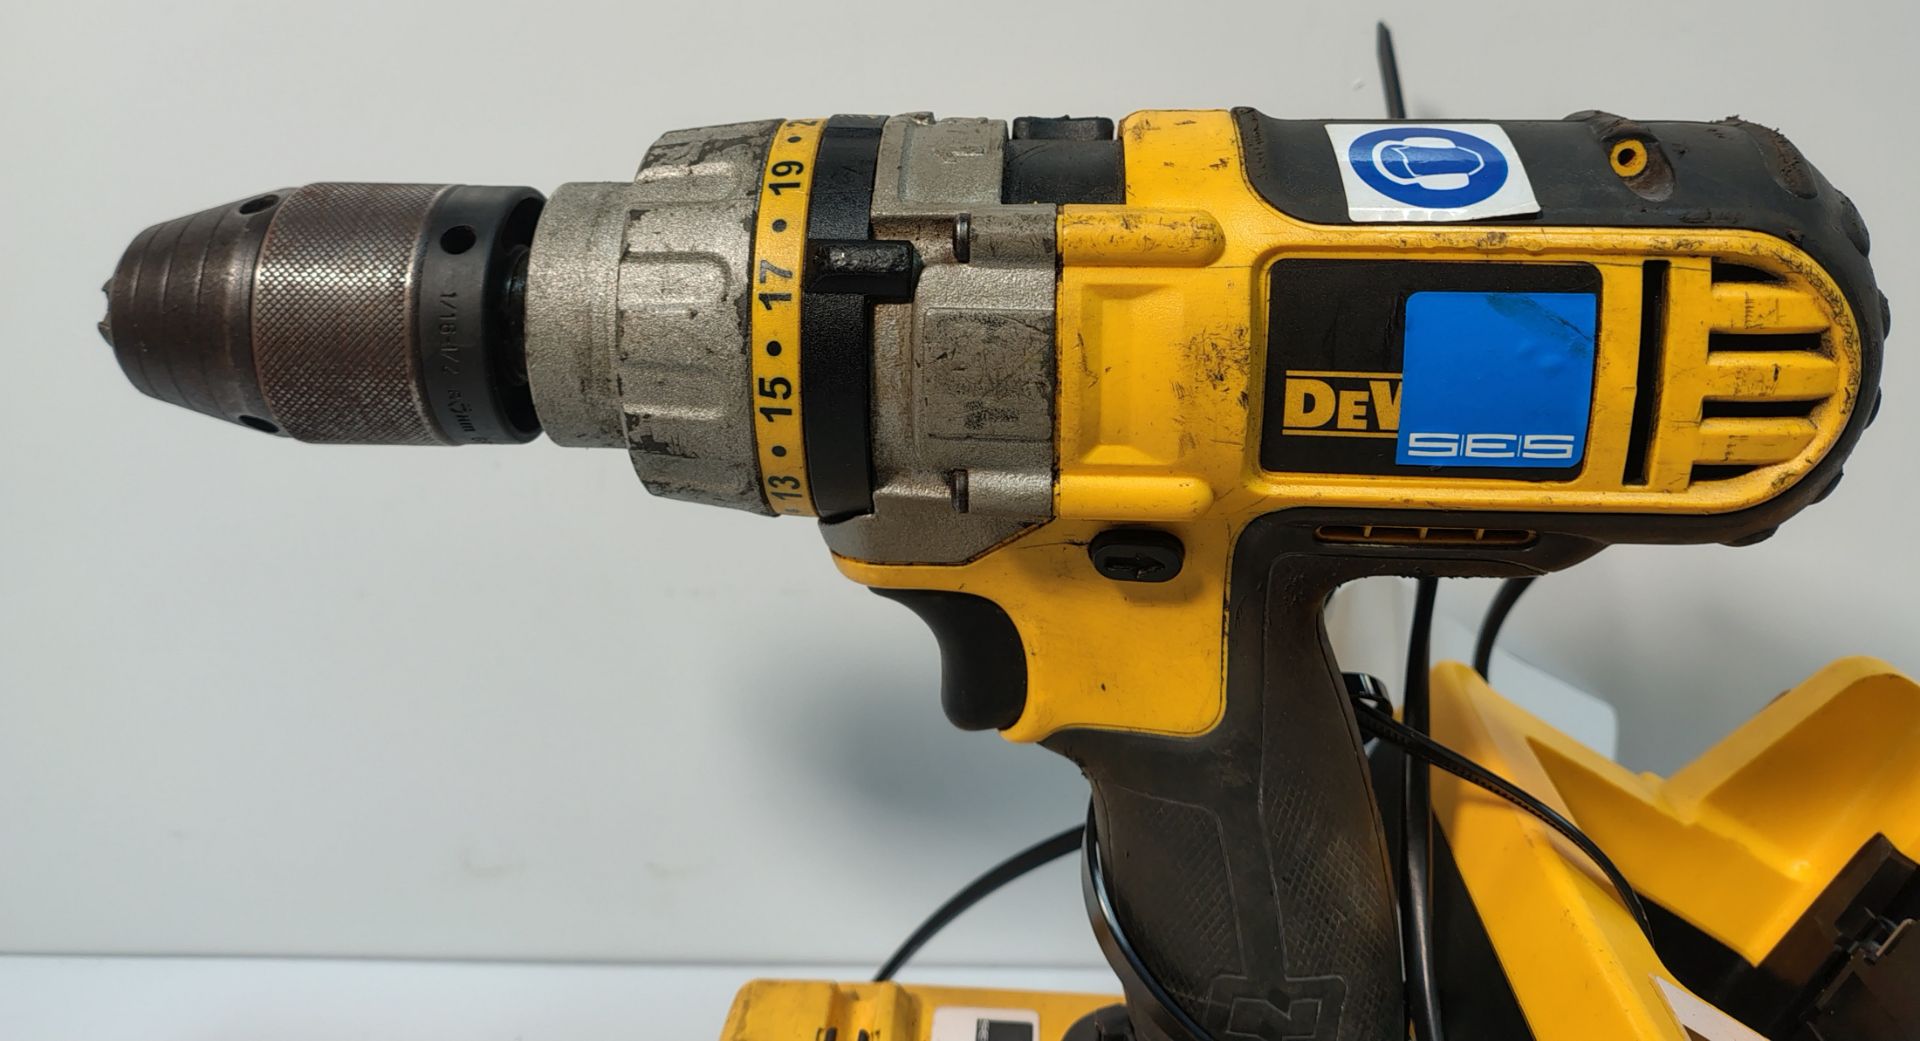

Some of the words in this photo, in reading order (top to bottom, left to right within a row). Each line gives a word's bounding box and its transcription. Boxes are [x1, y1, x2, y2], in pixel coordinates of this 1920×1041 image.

[768, 160, 804, 196] 19
[758, 260, 793, 310] 17
[758, 377, 792, 422] 15
[1408, 432, 1575, 459] SES
[768, 475, 803, 501] 13
